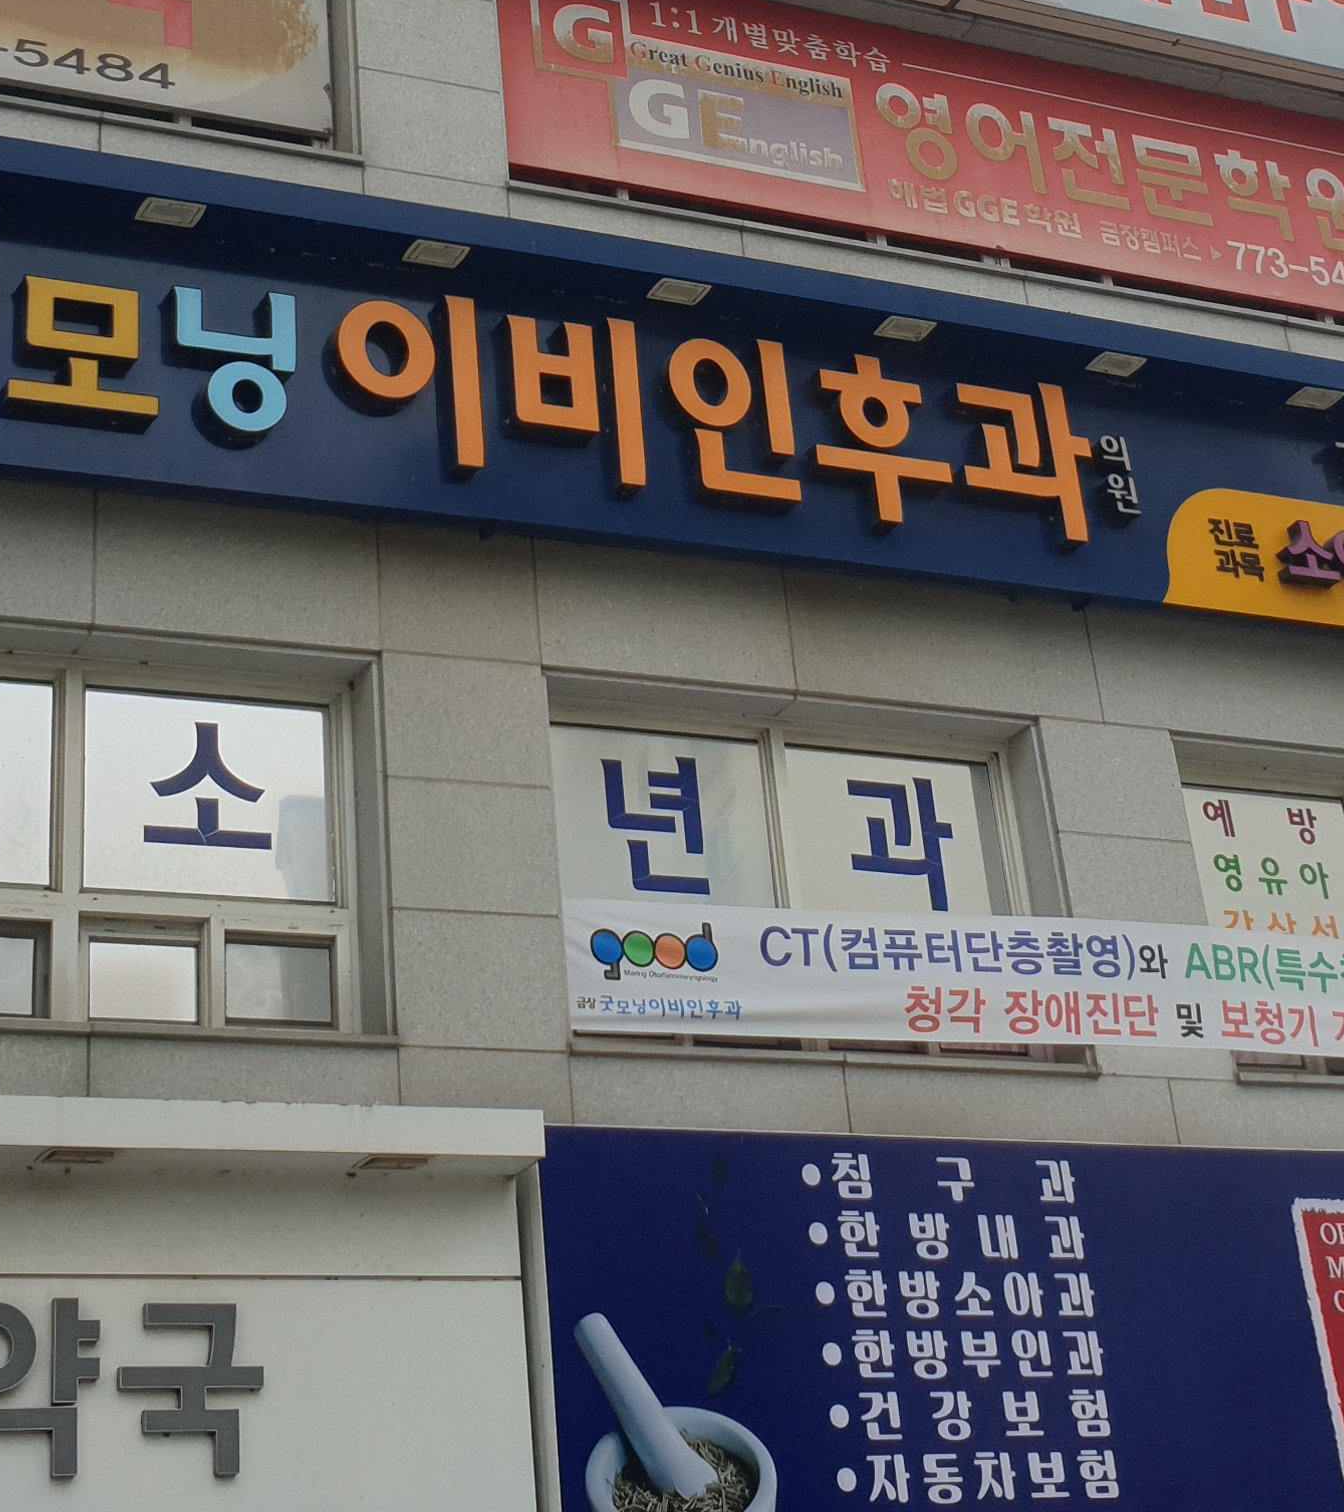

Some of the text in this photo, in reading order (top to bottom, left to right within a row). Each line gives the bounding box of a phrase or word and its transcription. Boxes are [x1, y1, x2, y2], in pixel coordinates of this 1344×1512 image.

[552, 2, 616, 65] G
[649, 1, 893, 74] 1:1 개별맞춤학습
[628, 39, 845, 101] Great Genius English
[886, 176, 949, 214] 해법
[954, 192, 1021, 227] GGE
[1025, 202, 1083, 240] 학원
[1099, 219, 1203, 262] 금장캠퍼스
[335, 294, 1094, 544] 이비인후과
[1099, 434, 1143, 516] 의원
[1207, 516, 1260, 551] 진료
[1215, 549, 1266, 583] 과목
[760, 922, 1169, 983] CT(컴퓨터단층촬영)와
[904, 985, 987, 1034] 청각
[1003, 987, 1159, 1039] 장애진단
[1175, 1001, 1205, 1039] 및
[1221, 999, 1319, 1048] 보청기
[844, 1268, 1096, 1321] 한방소아과
[851, 1328, 1106, 1381] 한방부인과
[866, 1449, 1121, 1506] 자동차보험
